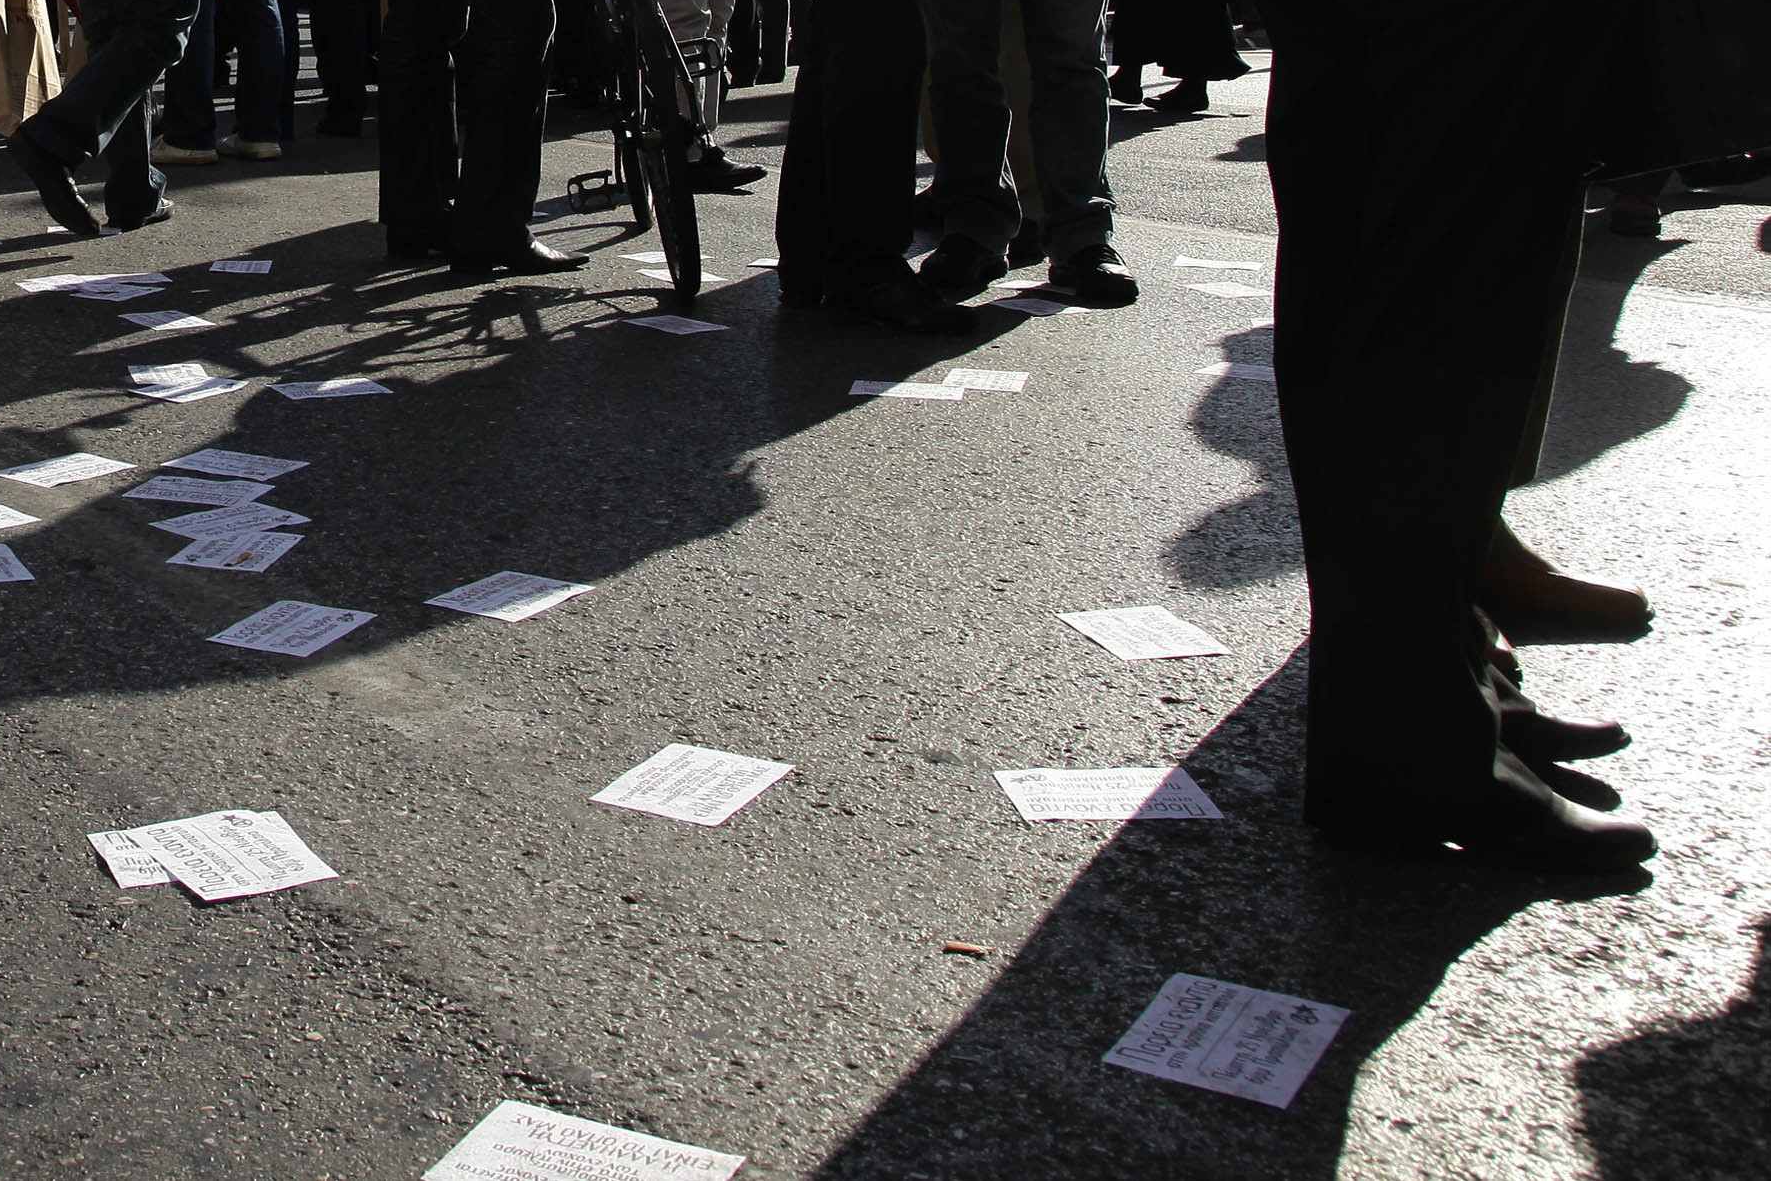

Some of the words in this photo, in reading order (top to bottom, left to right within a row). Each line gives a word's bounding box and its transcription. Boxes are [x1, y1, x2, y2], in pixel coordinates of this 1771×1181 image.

[146, 826, 205, 859] ενάντια
[243, 847, 266, 857] 25
[177, 858, 230, 893] Πορεία
[1115, 1020, 1186, 1065] Πορεία
[1164, 980, 1218, 1020] ενάντια
[510, 1113, 557, 1131] ΜΑΣ
[560, 1128, 617, 1146] ΟΠΛΟ
[647, 1148, 715, 1171] ΕΙΝΑΙ
